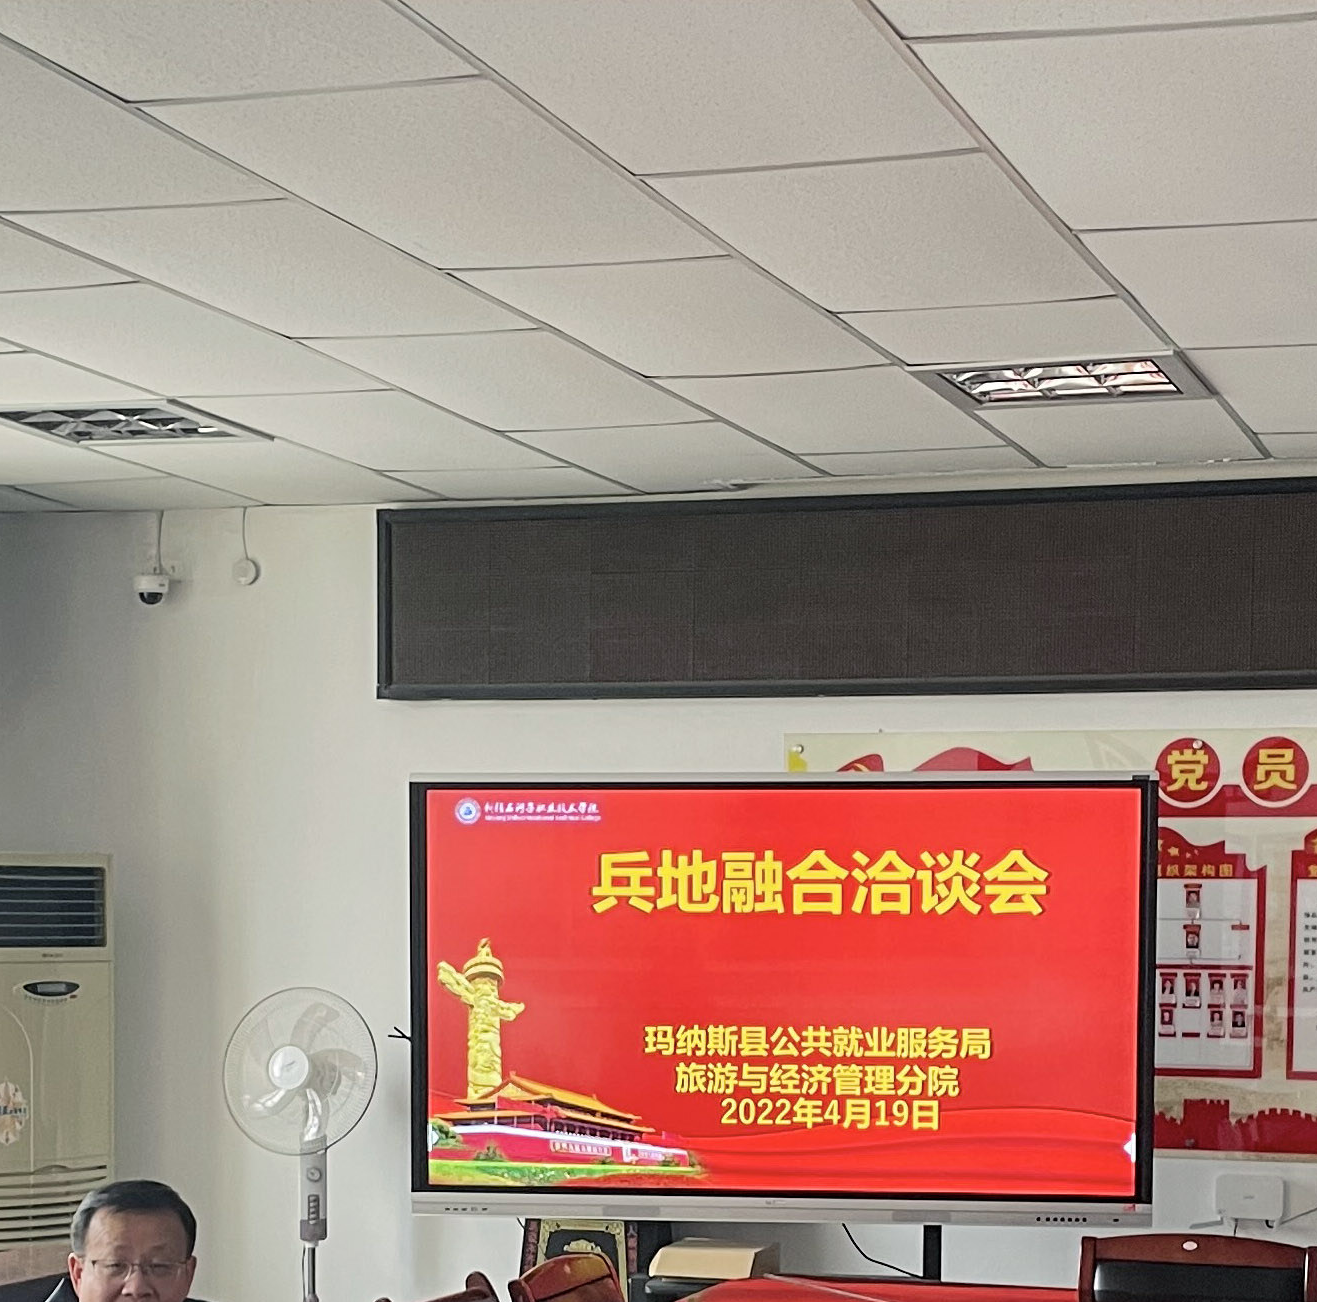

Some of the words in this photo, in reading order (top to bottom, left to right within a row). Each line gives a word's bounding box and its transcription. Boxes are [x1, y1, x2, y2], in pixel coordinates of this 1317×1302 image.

[592, 849, 1050, 915] 兵地融合洽谈会
[644, 1026, 993, 1060] 玛纳斯县公共就业服务局
[675, 1062, 960, 1097] 旅游与经济管理分院
[720, 1098, 940, 1130] 2022年4月19日
